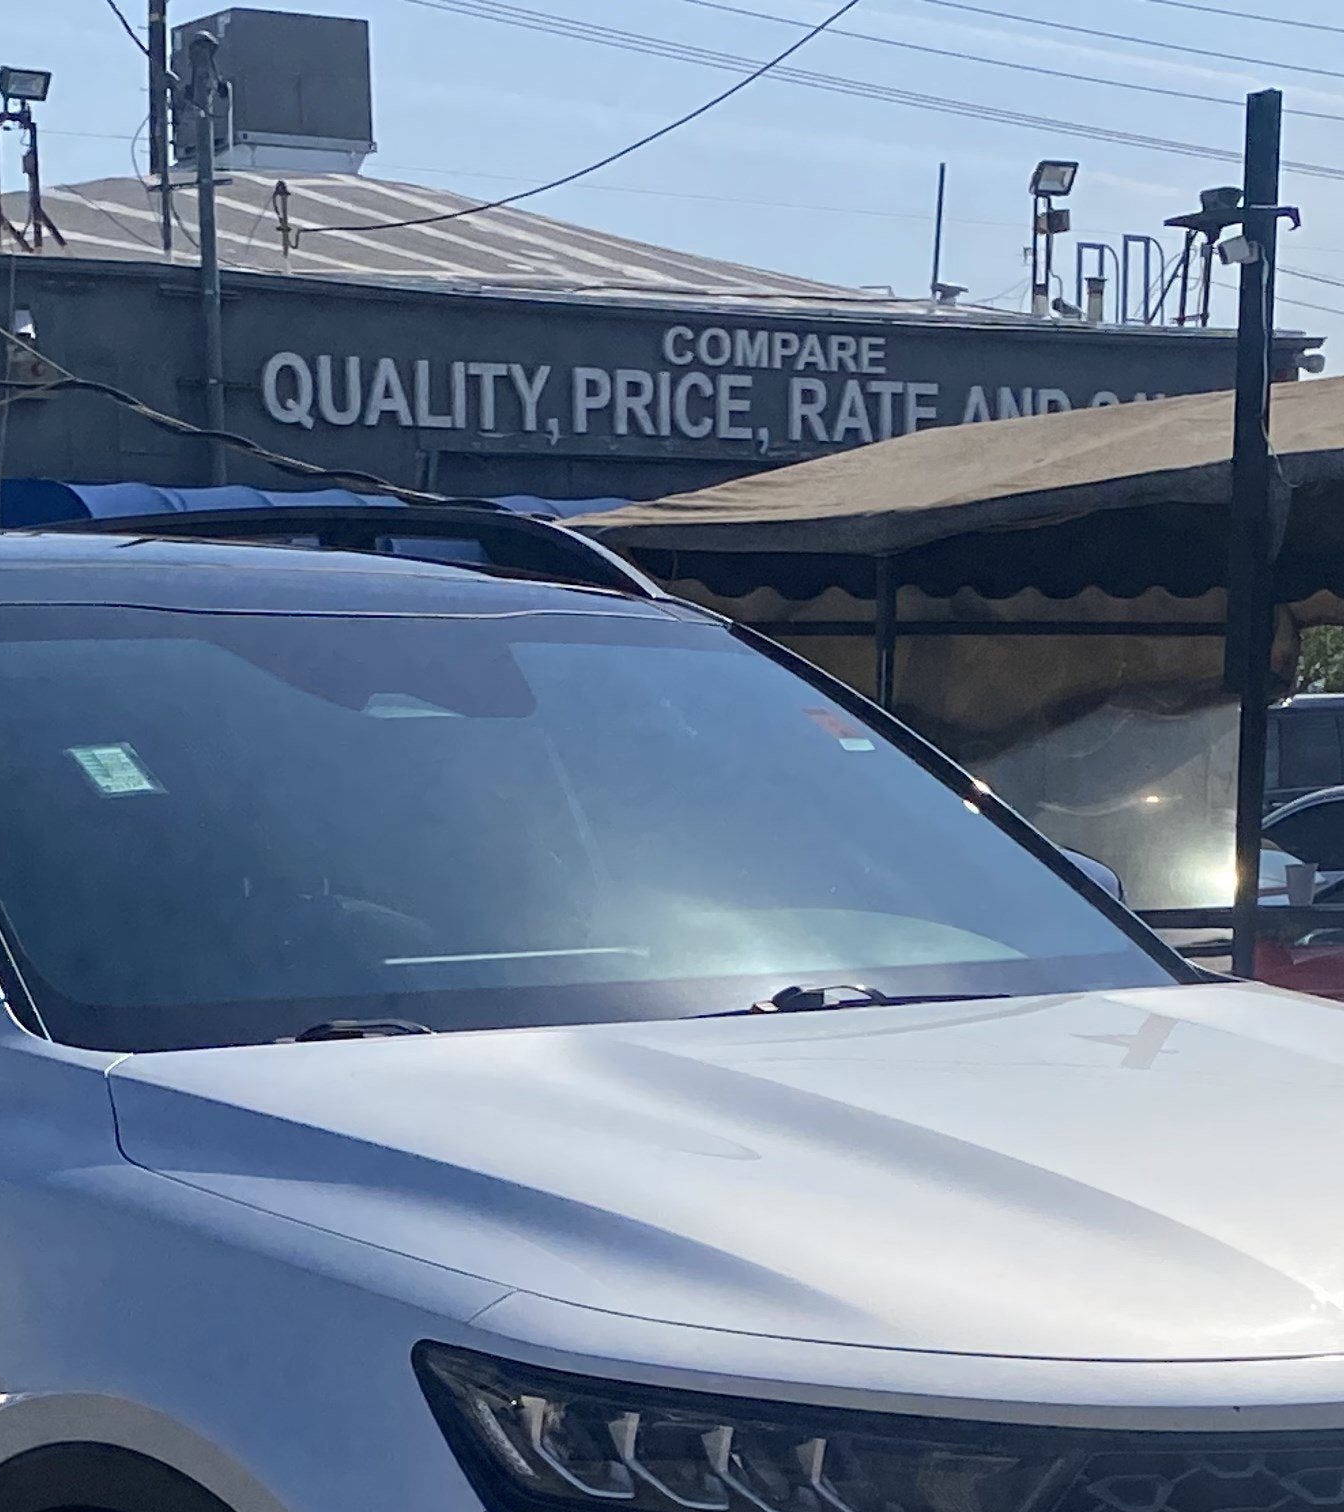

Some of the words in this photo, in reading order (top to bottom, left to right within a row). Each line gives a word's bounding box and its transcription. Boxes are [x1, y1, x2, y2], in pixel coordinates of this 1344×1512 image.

[664, 325, 887, 374] COMPARE
[262, 351, 560, 445] QUALITY,
[572, 366, 770, 454] PRICE,
[789, 378, 938, 442] RATE
